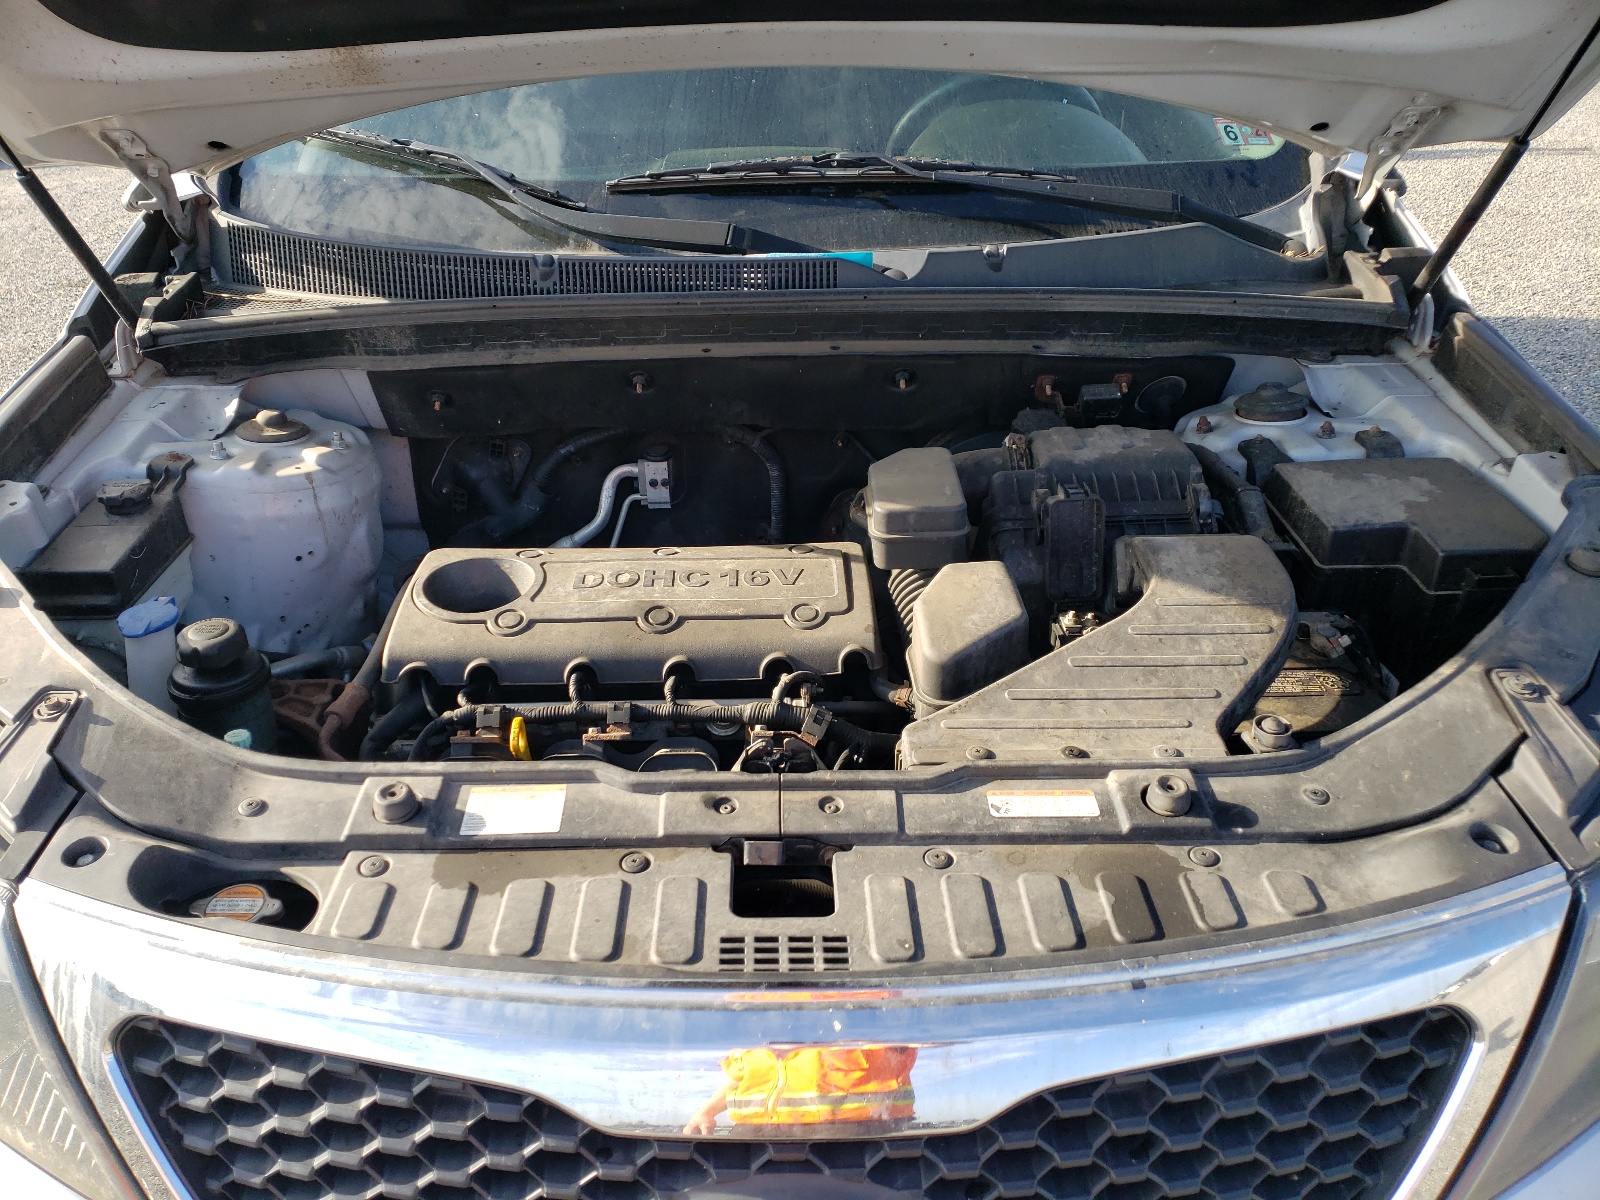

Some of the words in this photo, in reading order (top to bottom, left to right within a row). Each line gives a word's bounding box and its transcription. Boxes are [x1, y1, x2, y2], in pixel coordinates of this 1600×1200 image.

[1223, 125, 1238, 141] 6
[572, 568, 711, 590] DOHC
[719, 567, 805, 588] 16V
